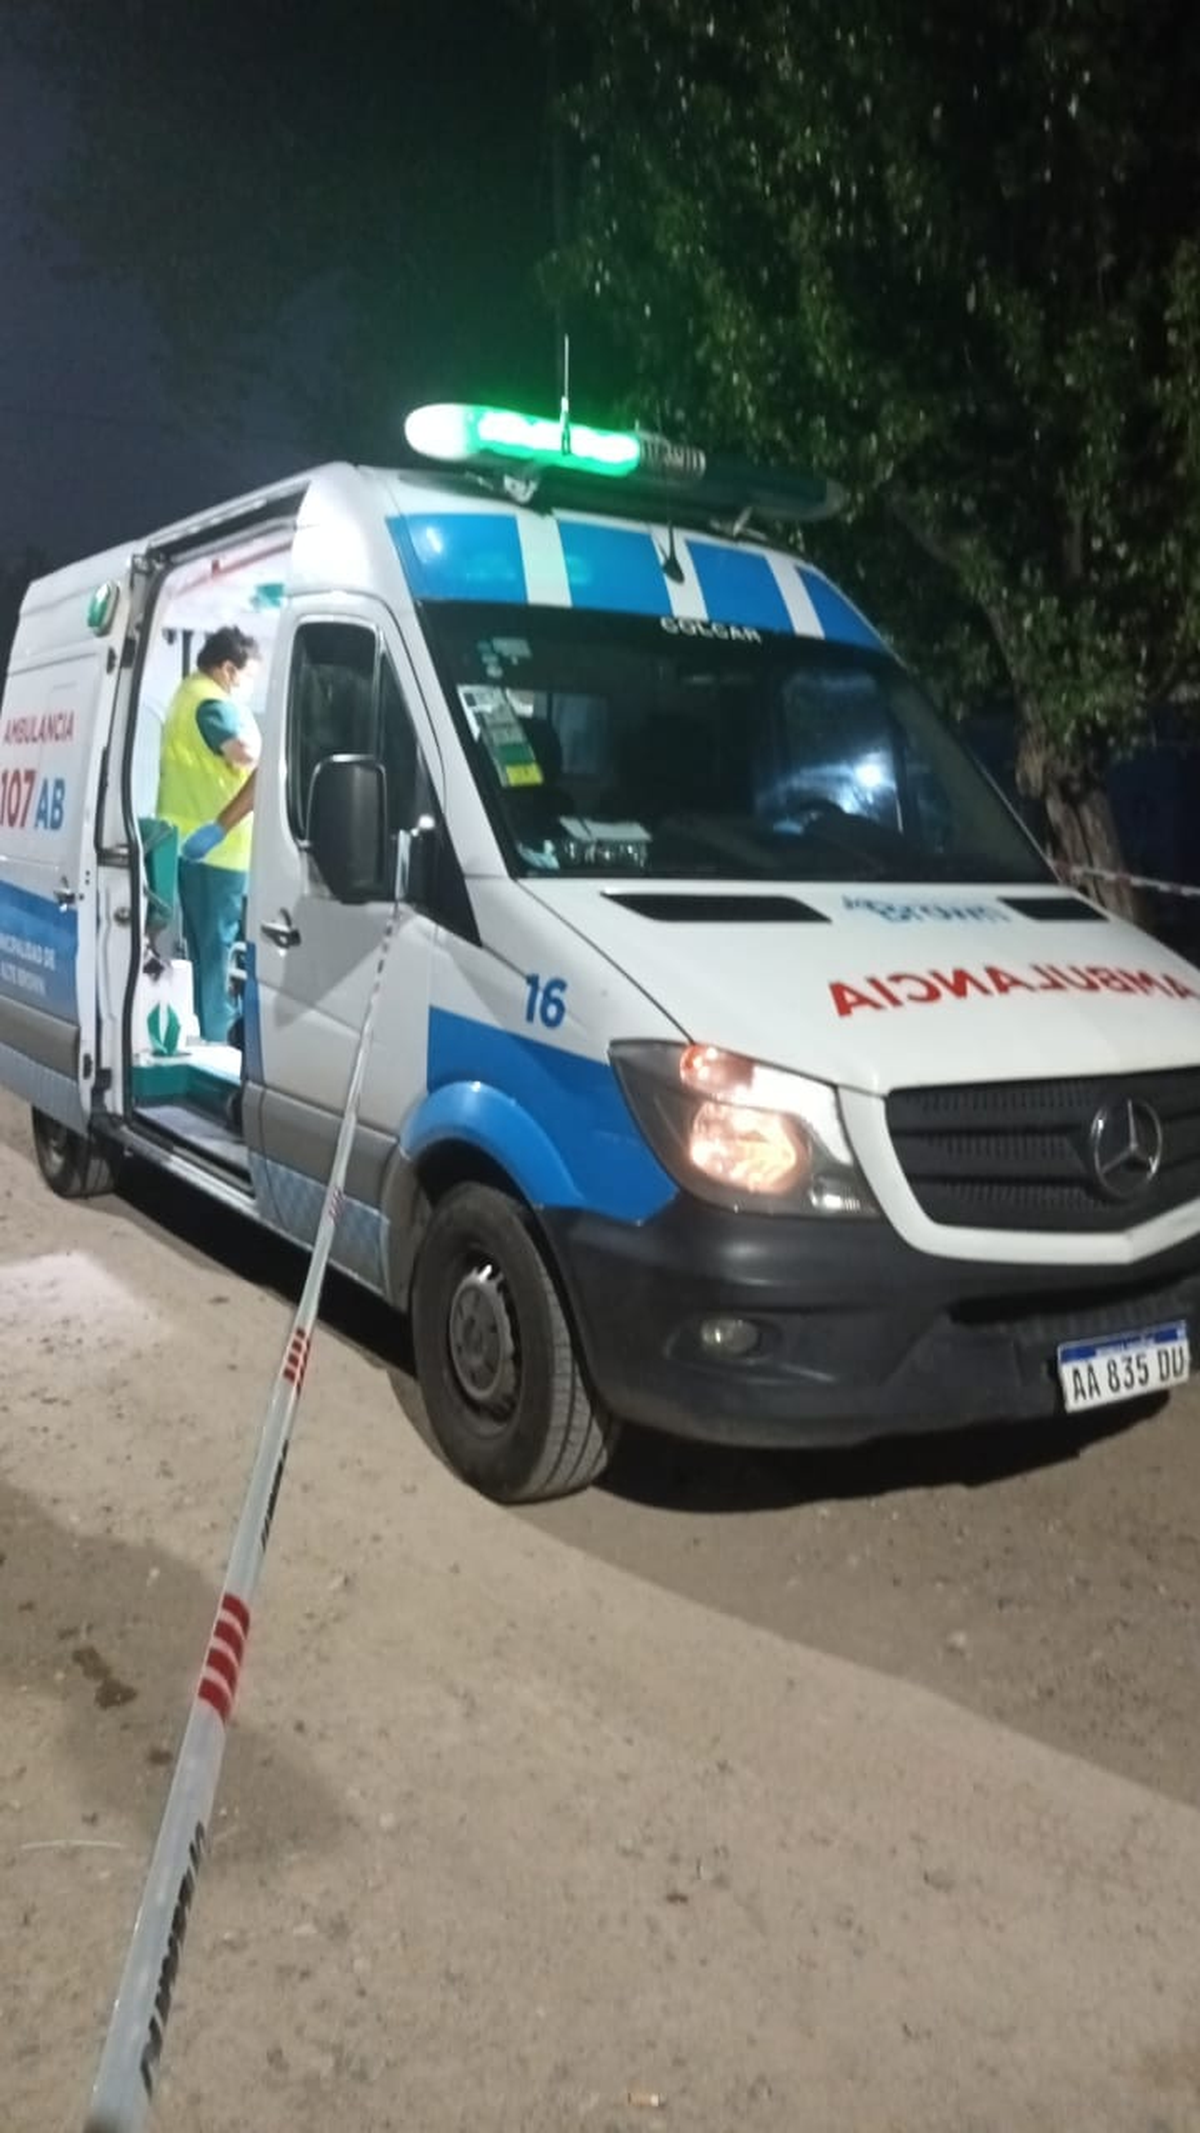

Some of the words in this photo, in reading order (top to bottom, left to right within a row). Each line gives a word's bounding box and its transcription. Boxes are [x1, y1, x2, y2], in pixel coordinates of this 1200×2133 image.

[4, 709, 75, 744] AMBULANCIA
[0, 769, 36, 828] 107
[34, 778, 65, 831] AB
[526, 973, 567, 1029] 16
[1073, 1364, 1102, 1402] AA
[1106, 1353, 1150, 1393] 835
[1157, 1345, 1184, 1382] DU
